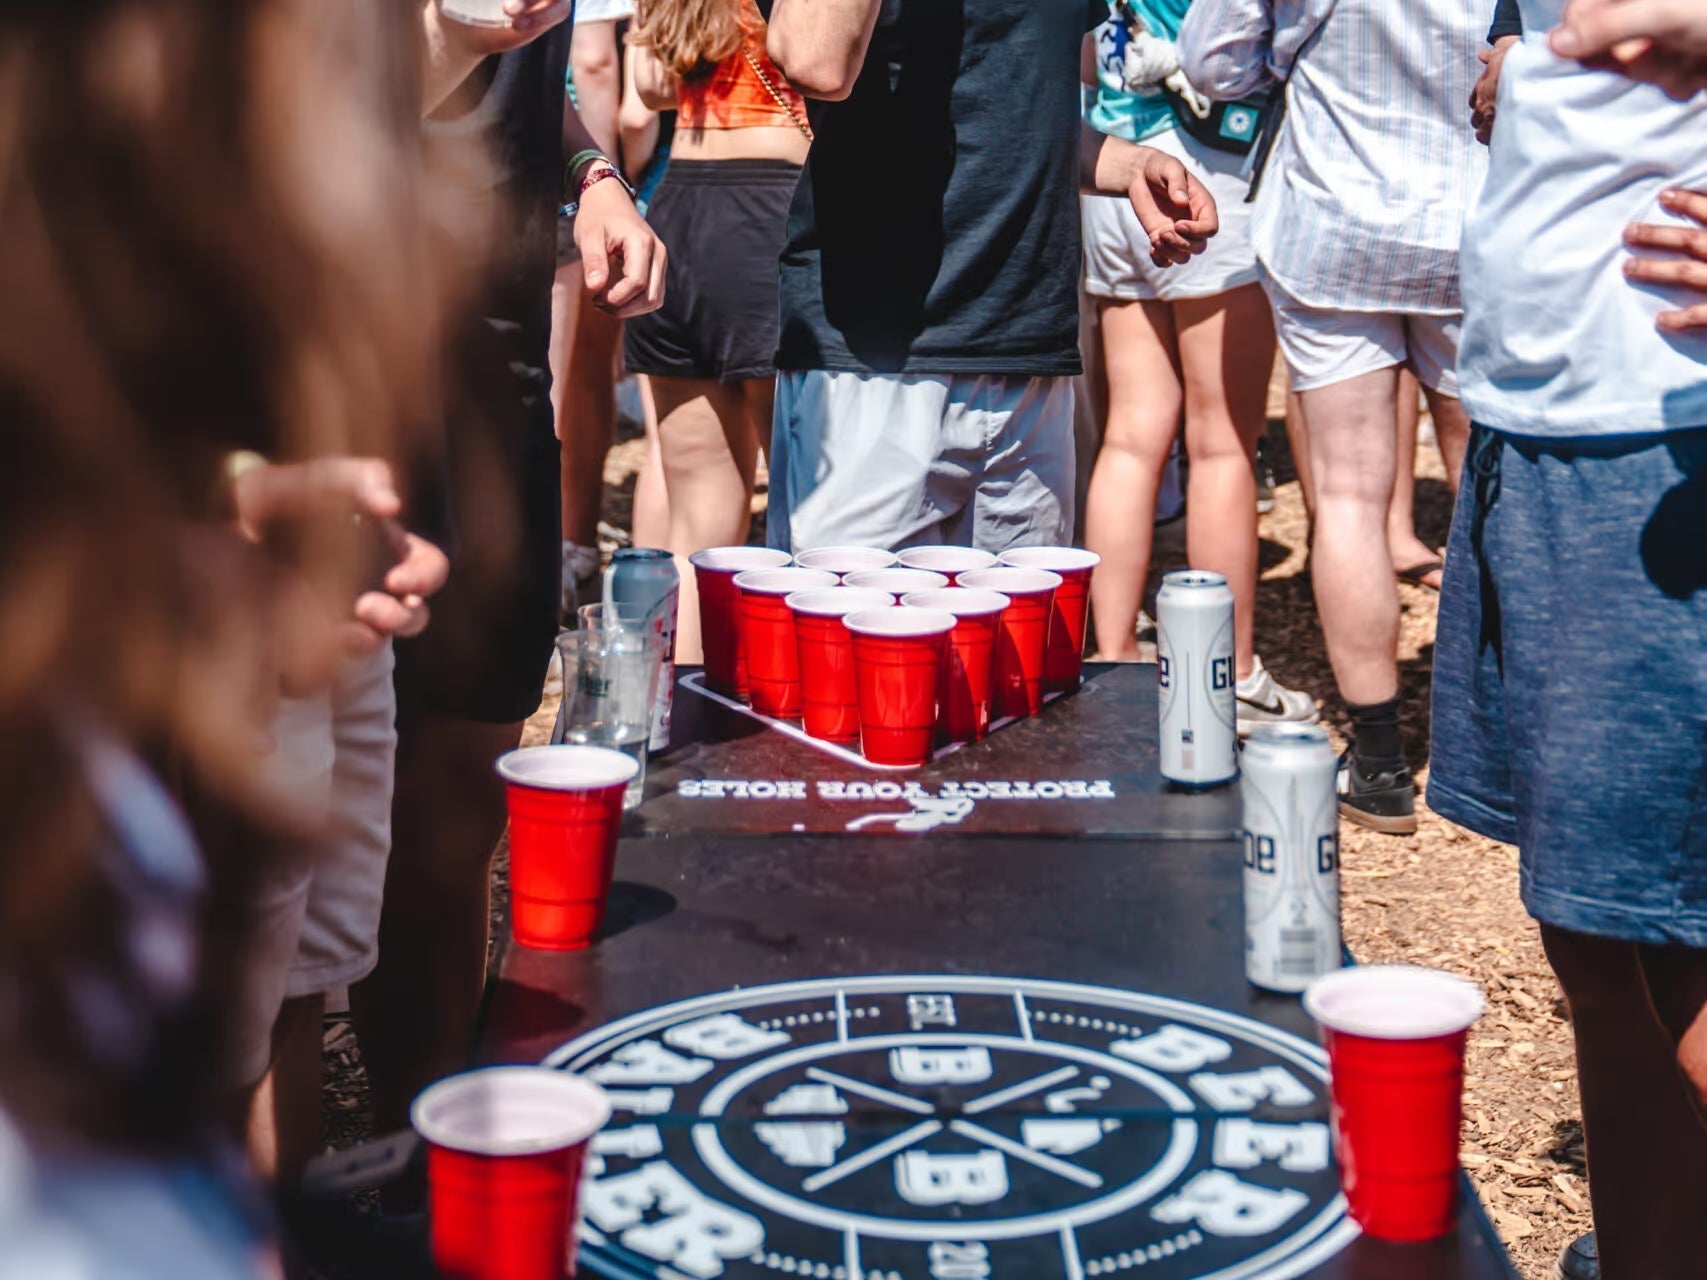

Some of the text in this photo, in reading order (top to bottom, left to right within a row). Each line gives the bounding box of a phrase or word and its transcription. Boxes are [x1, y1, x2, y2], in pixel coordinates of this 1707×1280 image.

[678, 778, 1115, 799] PROTECT YOUR HOLES
[1109, 1023, 1330, 1237] BEER
